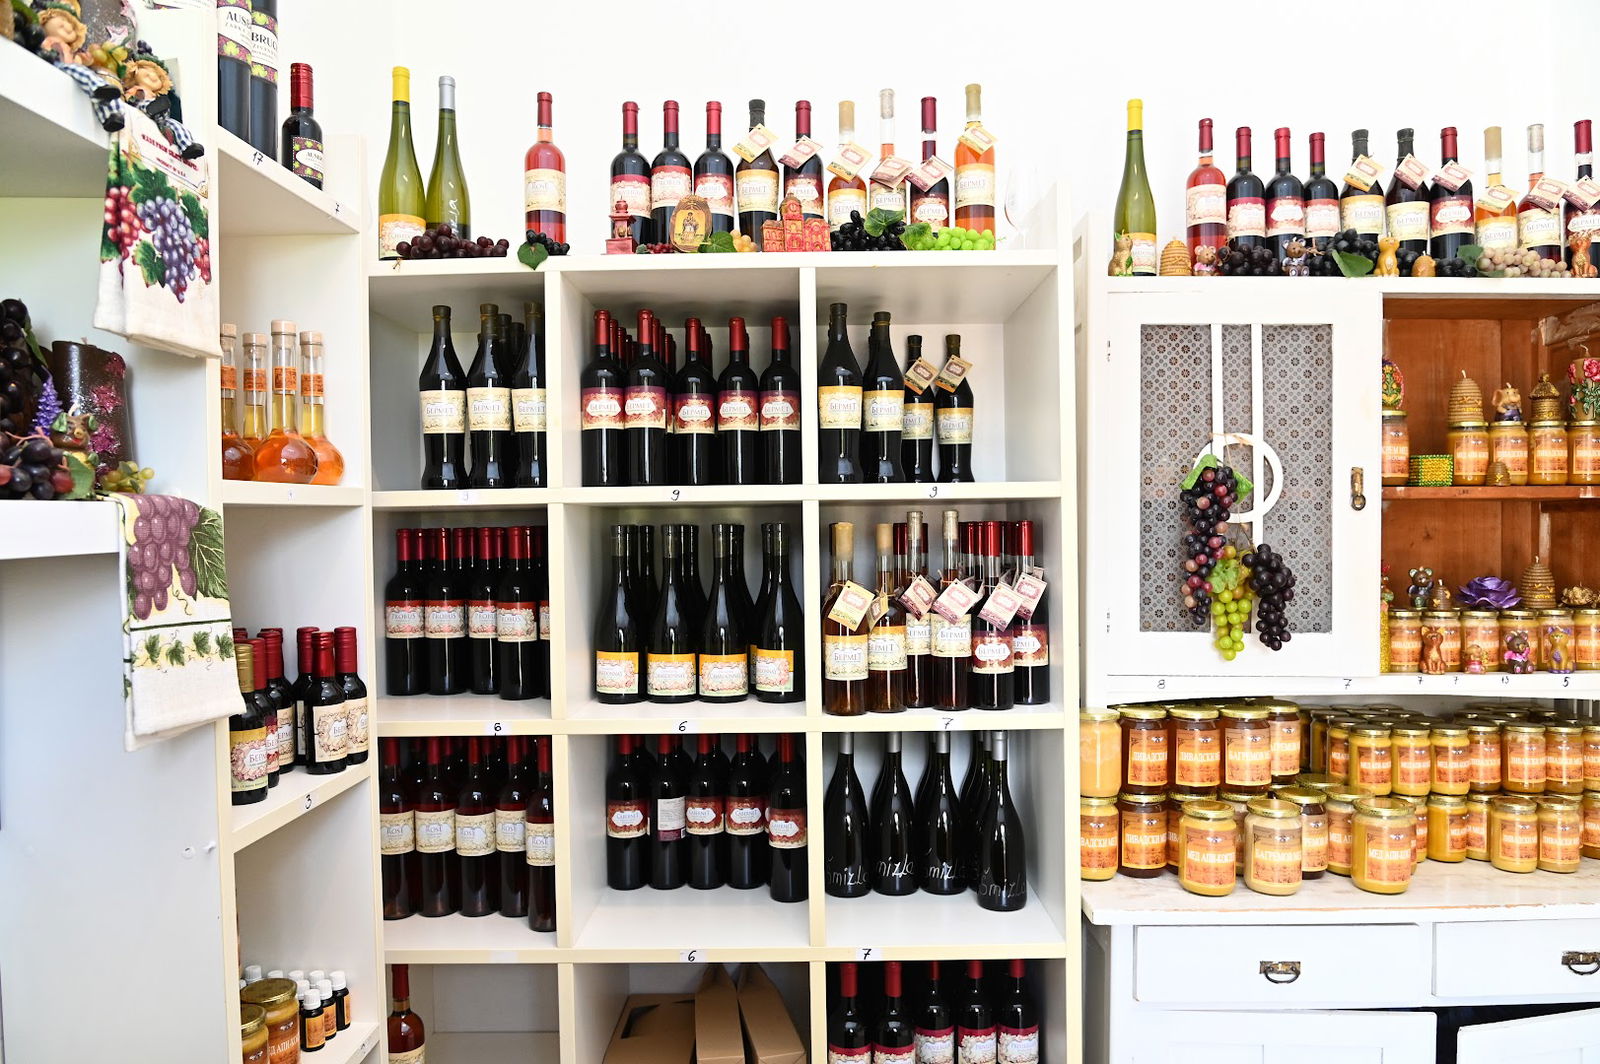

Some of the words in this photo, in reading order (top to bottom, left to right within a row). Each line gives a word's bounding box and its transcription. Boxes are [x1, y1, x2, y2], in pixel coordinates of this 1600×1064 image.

[252, 151, 264, 165] 17
[670, 489, 680, 501] 9
[1157, 679, 1165, 690] 8
[1343, 678, 1352, 690] 7
[1562, 676, 1571, 687] 5
[494, 722, 502, 732] 6
[679, 721, 688, 732] 6
[942, 717, 954, 729] 7
[304, 794, 313, 809] 3
[687, 950, 696, 962] 6
[862, 948, 872, 960] 7
